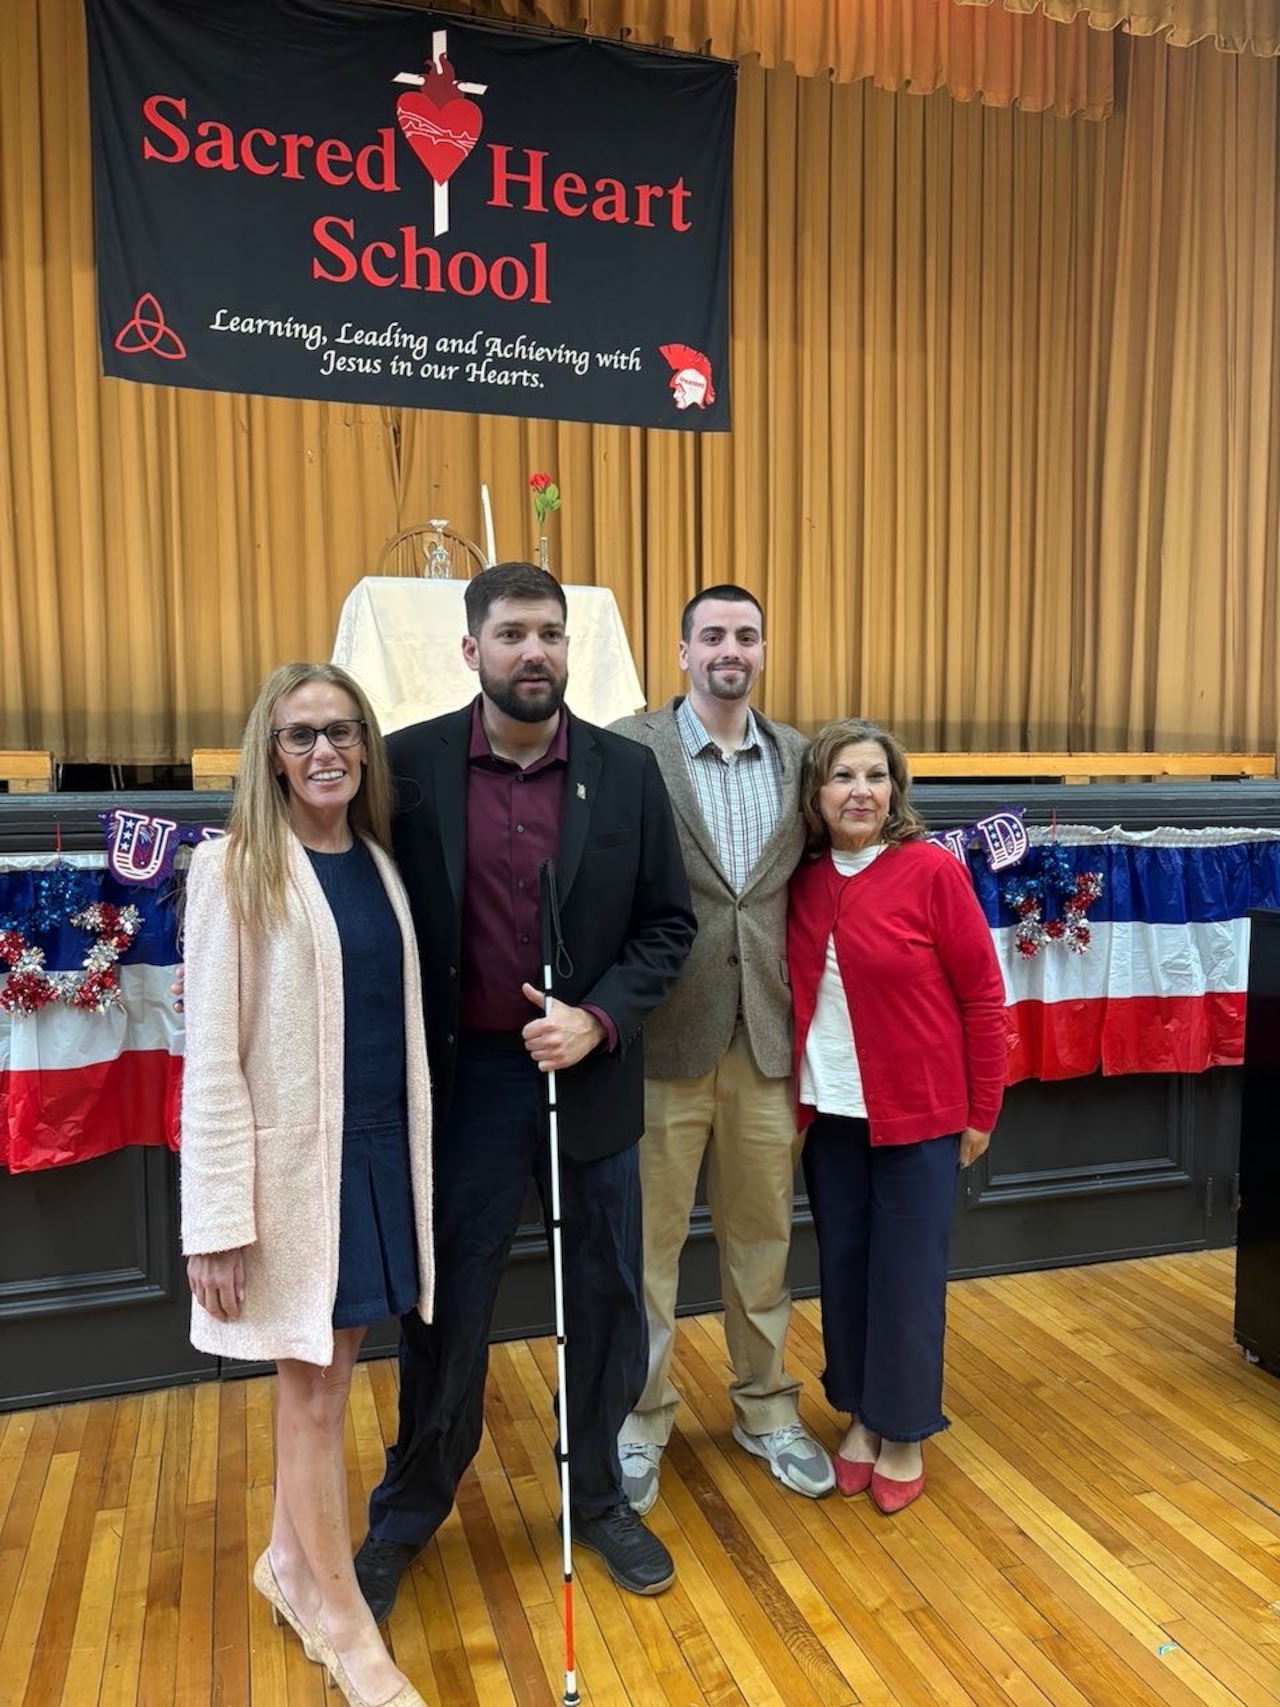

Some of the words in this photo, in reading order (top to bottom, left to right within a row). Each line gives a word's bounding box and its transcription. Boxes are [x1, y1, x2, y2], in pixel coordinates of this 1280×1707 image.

[142, 95, 401, 193] Sacred
[486, 144, 692, 232] Heart
[312, 215, 551, 304] School
[209, 308, 328, 351] Learning,
[334, 322, 429, 361] Leading
[435, 330, 484, 356] and
[484, 334, 590, 376] Achieving
[595, 347, 642, 372] with
[319, 349, 382, 376] Jesus
[389, 354, 414, 377] in
[419, 363, 460, 381] our
[465, 357, 545, 389] Hearts.
